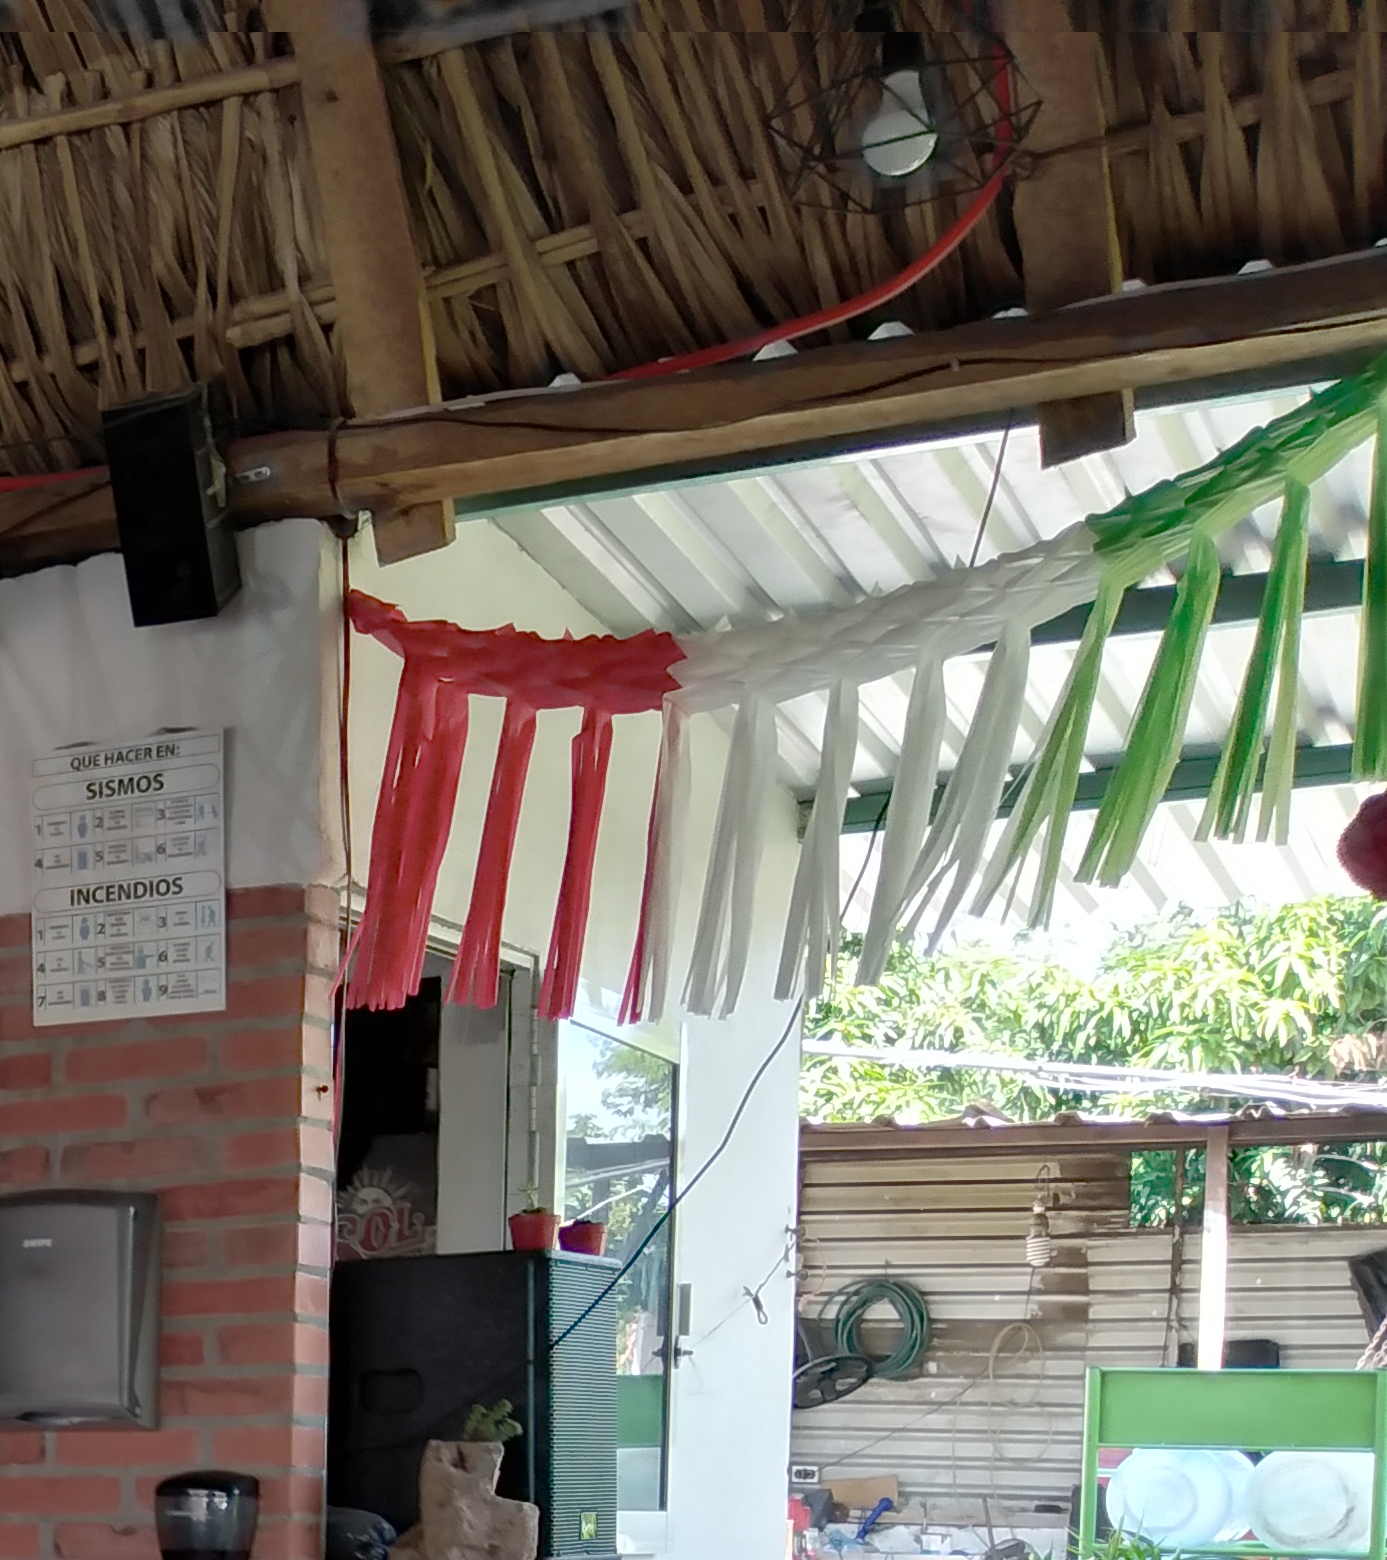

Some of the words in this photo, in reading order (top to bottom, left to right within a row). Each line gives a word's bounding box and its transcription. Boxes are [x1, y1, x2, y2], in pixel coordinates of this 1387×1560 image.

[70, 754, 100, 772] QUE
[104, 747, 152, 765] HACER
[156, 743, 180, 757] EN:
[86, 773, 164, 800] SISMOS
[157, 808, 166, 820] 3
[95, 816, 104, 829] 2
[157, 842, 166, 855] 6
[70, 877, 184, 906] INCENDIOS
[158, 916, 167, 928] 3
[97, 923, 105, 935] 2
[158, 951, 168, 962] 6
[36, 963, 45, 974] 4
[159, 984, 168, 996] 9
[37, 995, 46, 1007] 7
